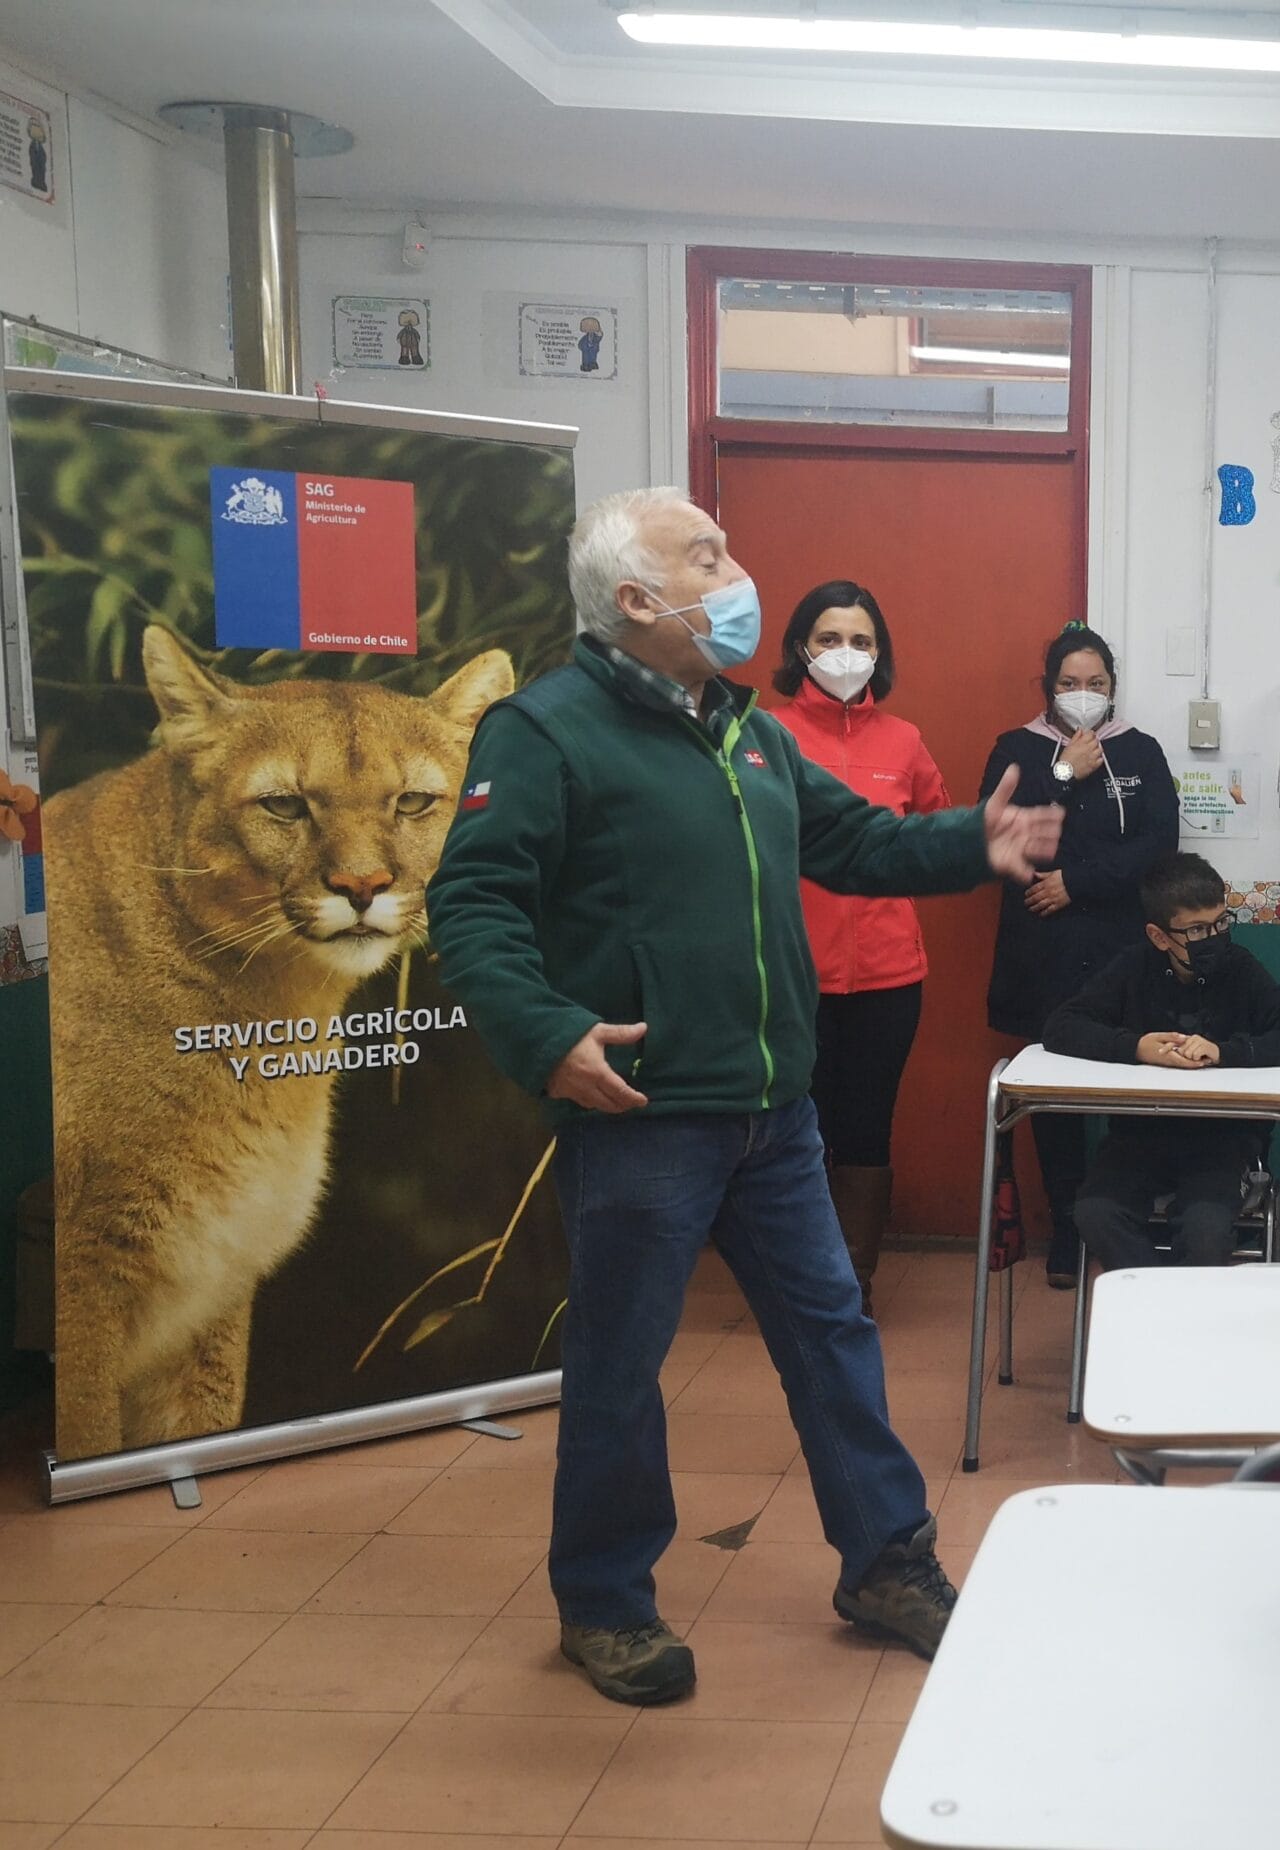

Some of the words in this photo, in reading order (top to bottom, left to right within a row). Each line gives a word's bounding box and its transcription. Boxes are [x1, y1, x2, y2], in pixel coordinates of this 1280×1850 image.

[305, 482, 335, 497] SAG
[305, 501, 353, 513] Ministerio
[354, 504, 366, 514] de
[306, 512, 357, 525] Agricultura
[308, 632, 361, 645] Gobierno
[363, 634, 378, 646] de
[379, 635, 408, 647] Chile
[1183, 771, 1211, 780] antes
[1182, 784, 1195, 793] de
[174, 1016, 318, 1052] SERVICIO
[325, 1006, 468, 1040] AGRÍCOLA
[229, 1056, 250, 1081] Y
[258, 1041, 421, 1079] GANADERO
